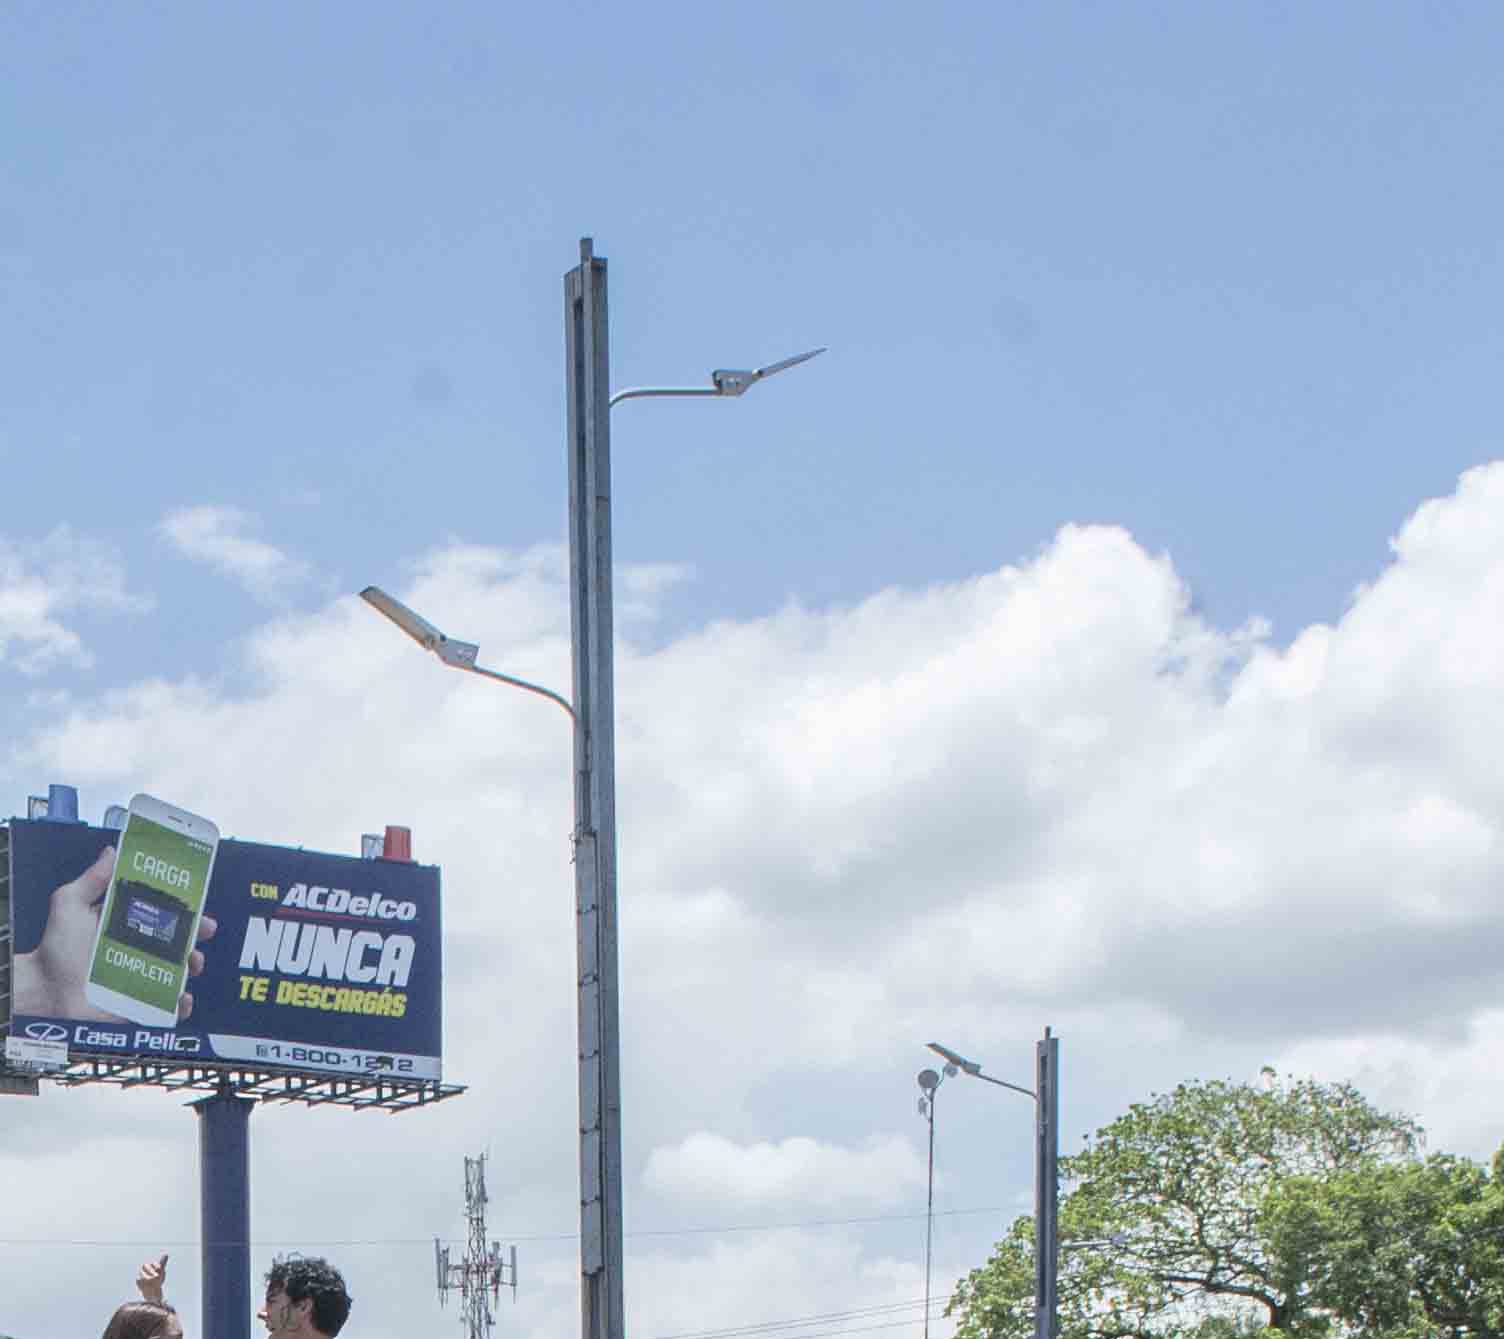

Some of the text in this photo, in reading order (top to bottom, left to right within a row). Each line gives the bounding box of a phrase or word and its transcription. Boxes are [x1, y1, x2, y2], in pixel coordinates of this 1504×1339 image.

[132, 851, 191, 890] CARGA
[251, 881, 417, 921] CON ACDelco
[104, 948, 175, 987] COMPLETA
[239, 916, 416, 987] NUNCA
[240, 975, 271, 1002] TE
[73, 1026, 127, 1048] Casa
